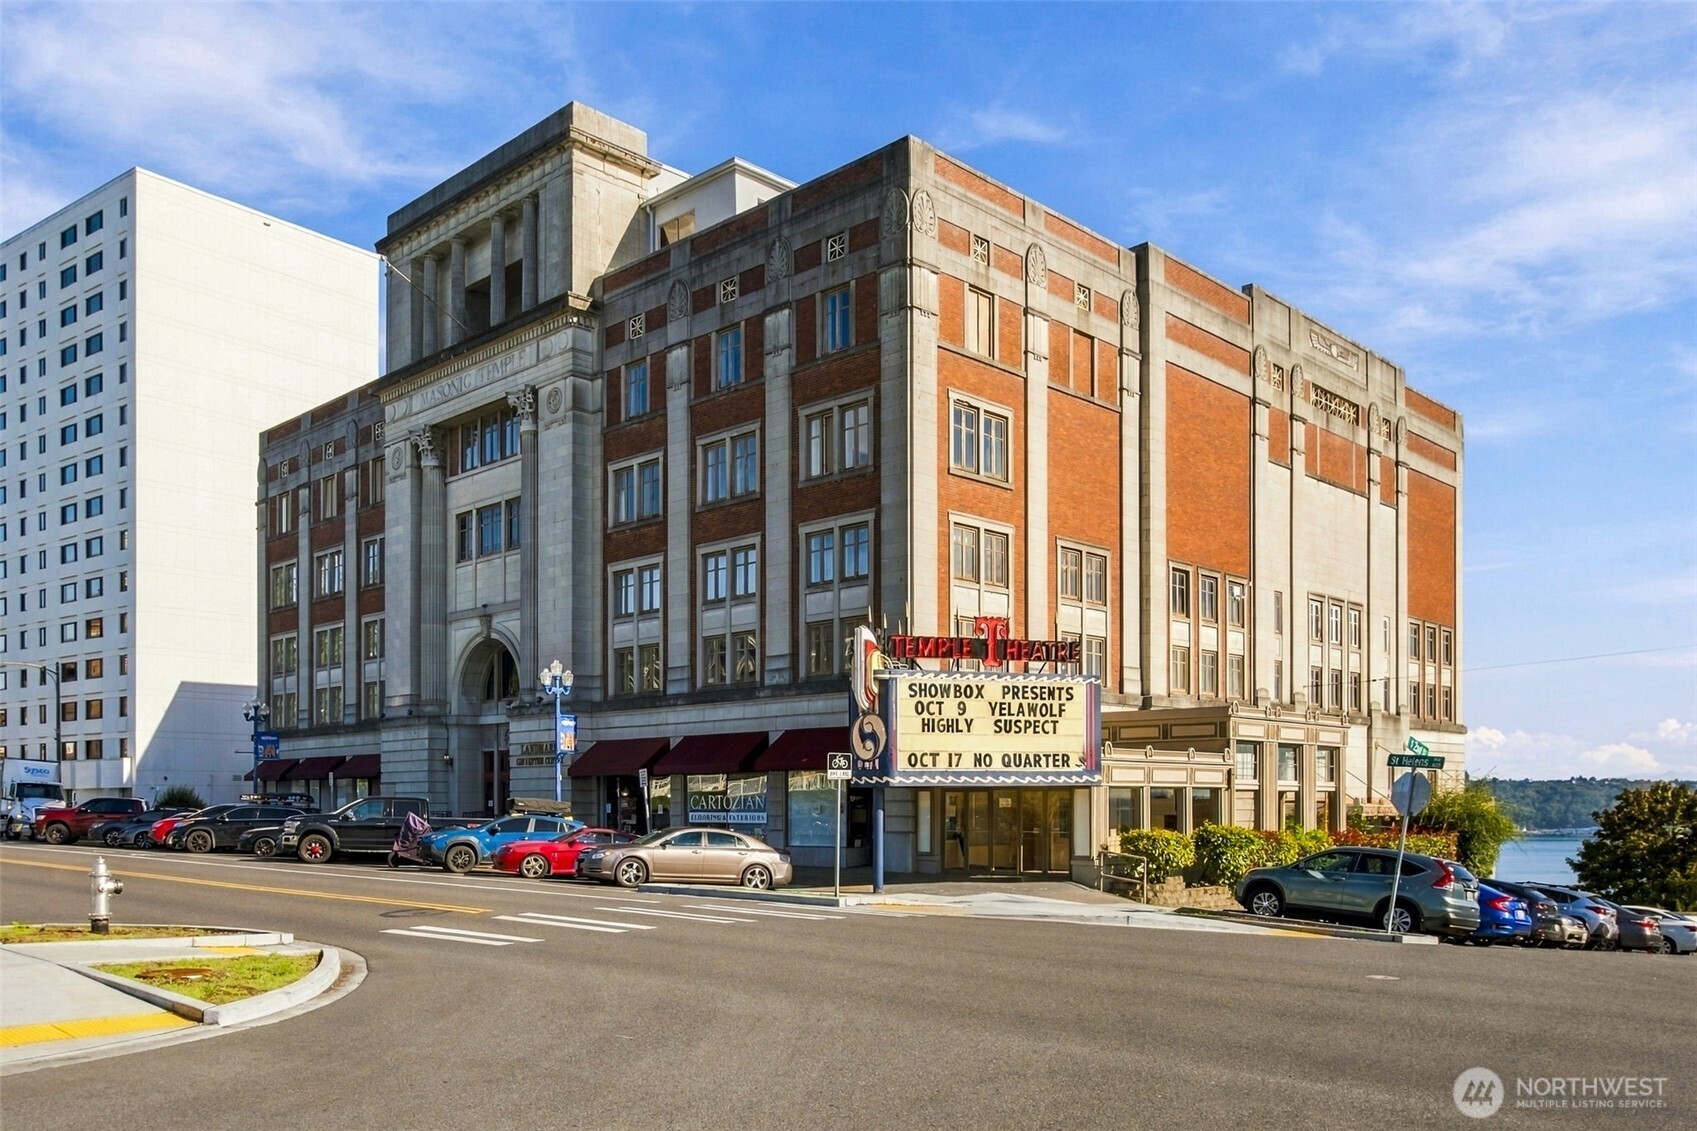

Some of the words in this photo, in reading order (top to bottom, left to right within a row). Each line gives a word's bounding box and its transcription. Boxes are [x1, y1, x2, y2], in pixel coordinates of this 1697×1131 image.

[421, 373, 472, 405] MASONIC
[477, 349, 527, 381] TEMPLE
[891, 635, 972, 659] TEMPLE
[974, 615, 1081, 668] THEATRE
[908, 682, 985, 699] SHOWBOX
[1002, 685, 1074, 701] PRESENTS
[914, 700, 945, 716] OCT
[957, 701, 967, 716] 9
[988, 701, 1066, 718] YELAWOLF
[921, 718, 974, 733] HIGHLY
[993, 718, 1060, 734] SUSPECT
[907, 752, 940, 768] OCT
[947, 752, 963, 768] 17
[973, 752, 993, 768] NO
[1001, 753, 1071, 768] QUARTER
[1390, 756, 1399, 765] St
[1401, 756, 1429, 767] Helens
[690, 794, 766, 810] CARTOZIAN
[729, 813, 765, 821] INTERIORS
